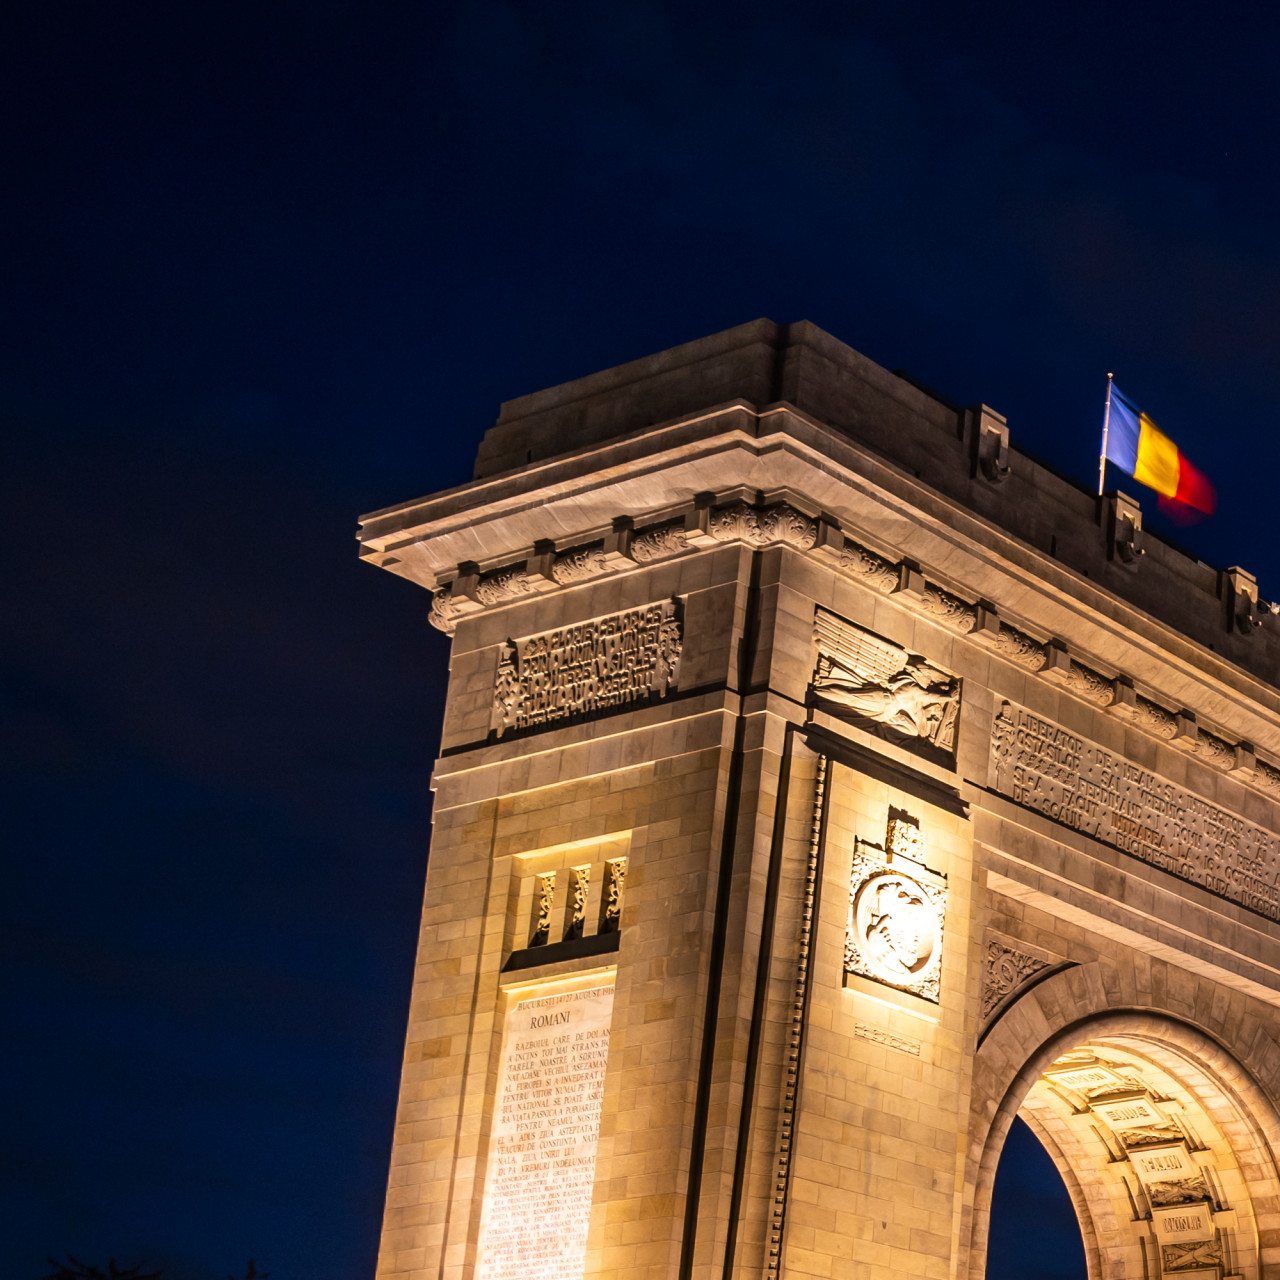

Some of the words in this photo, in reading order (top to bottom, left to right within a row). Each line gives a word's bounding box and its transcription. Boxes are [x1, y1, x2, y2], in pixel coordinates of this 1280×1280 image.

[1095, 748, 1111, 772] DE
[1254, 827, 1268, 849] DE
[529, 1010, 571, 1029] ROMANI
